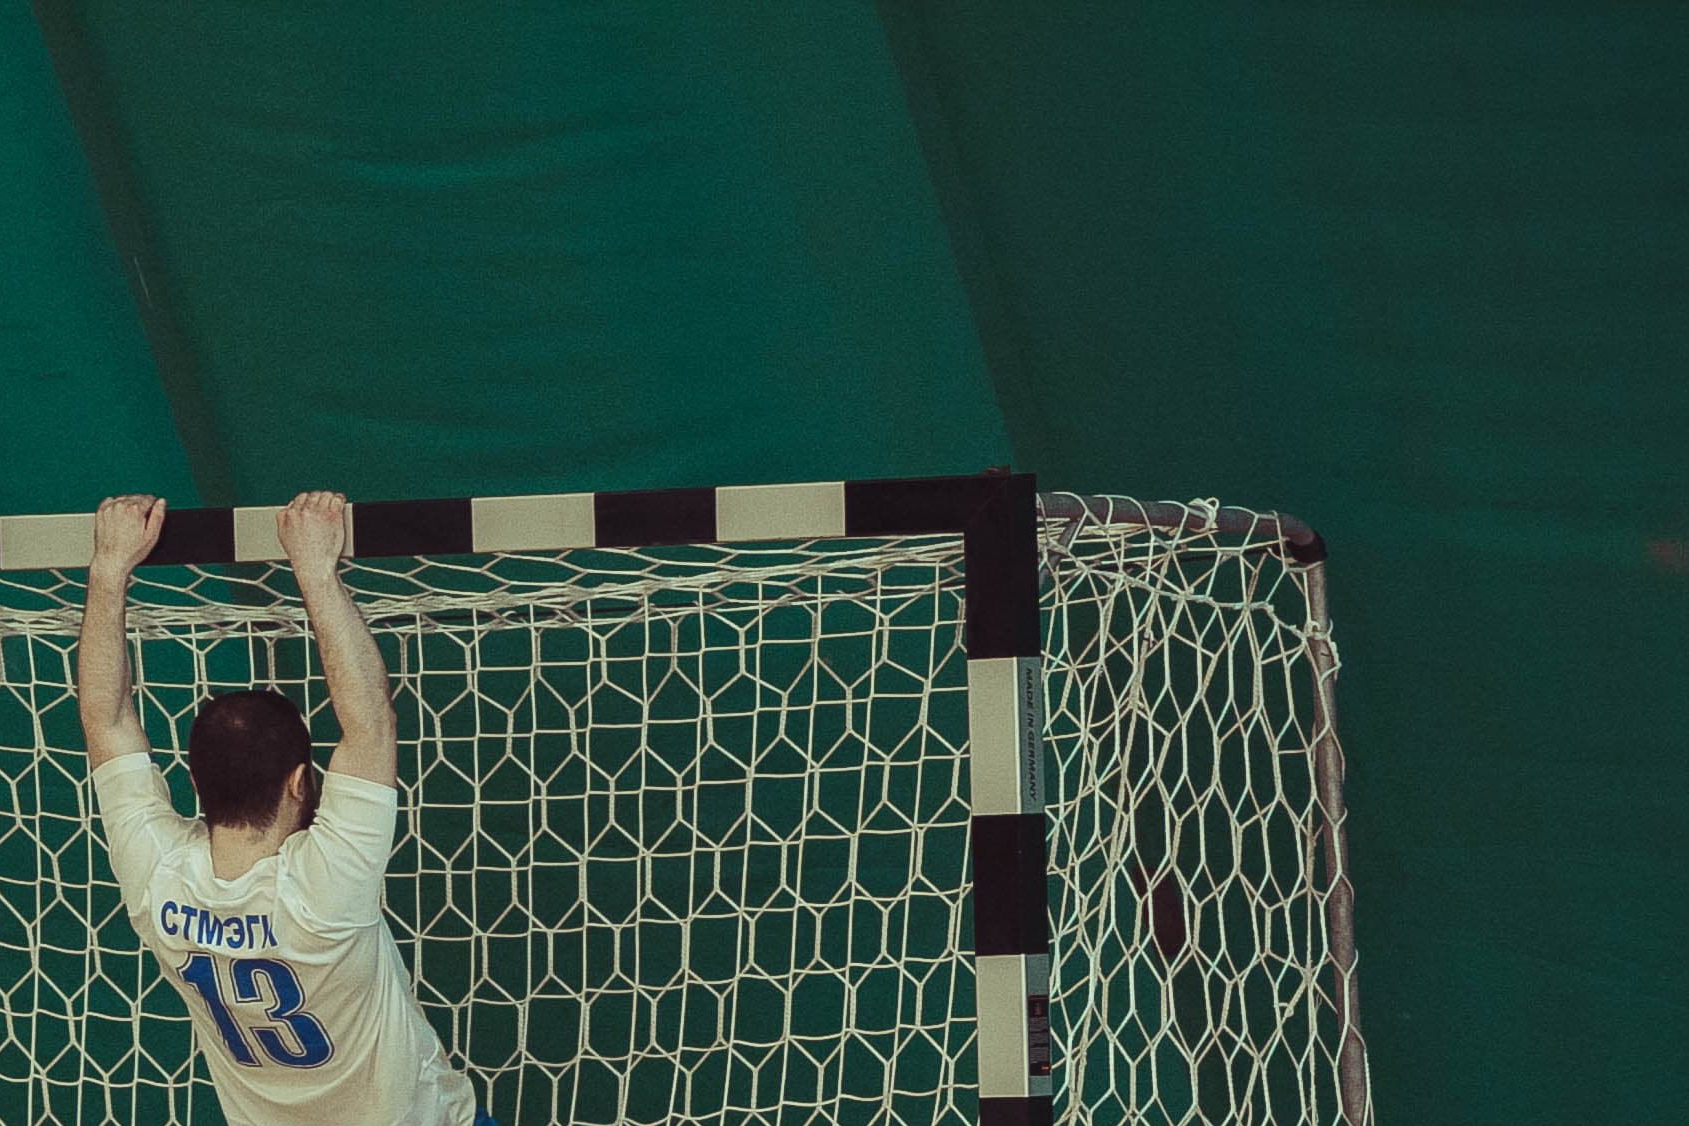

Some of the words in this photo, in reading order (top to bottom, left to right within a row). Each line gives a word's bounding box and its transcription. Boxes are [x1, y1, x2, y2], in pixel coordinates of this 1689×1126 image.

[1026, 667, 1034, 710] MADE
[1027, 712, 1035, 728] IN
[1027, 730, 1037, 802] GERMANY
[176, 951, 335, 1069] 13
